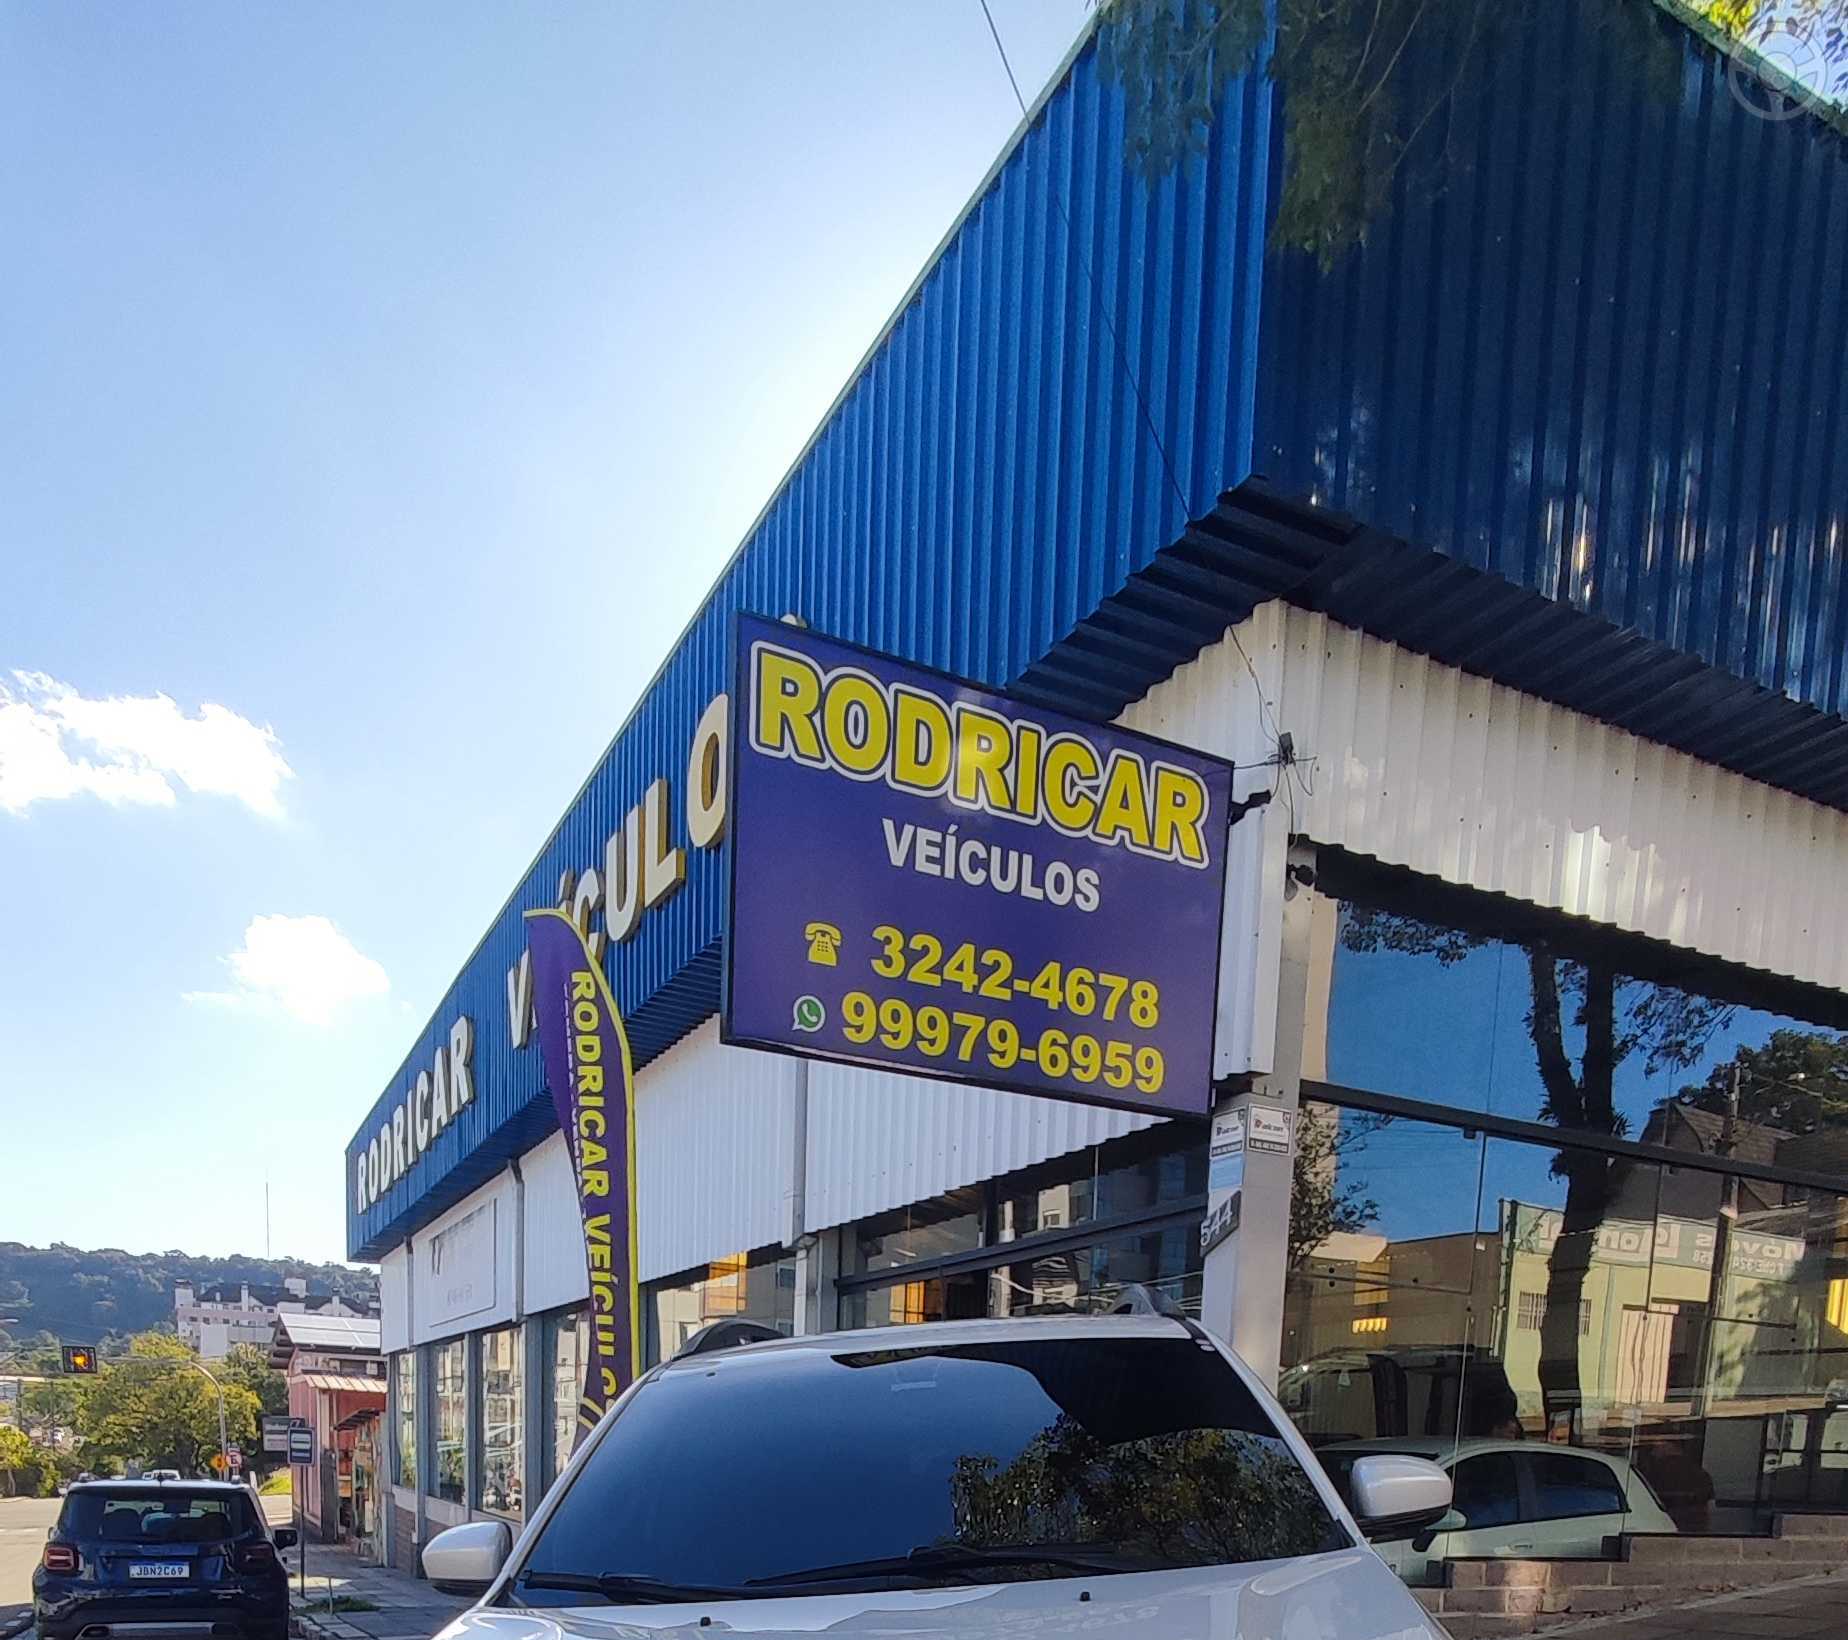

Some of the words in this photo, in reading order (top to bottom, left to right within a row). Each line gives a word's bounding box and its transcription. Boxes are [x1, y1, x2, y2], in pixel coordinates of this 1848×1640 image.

[752, 642, 1208, 867] RODRICAR
[881, 818, 1101, 912] VEÍCULOS
[870, 925, 1160, 1030] 3242-4678
[571, 970, 611, 1197] RODRICAR
[841, 991, 1165, 1094] 99979-6959
[356, 1015, 475, 1216] RODRICAR
[1200, 1199, 1233, 1247] 544
